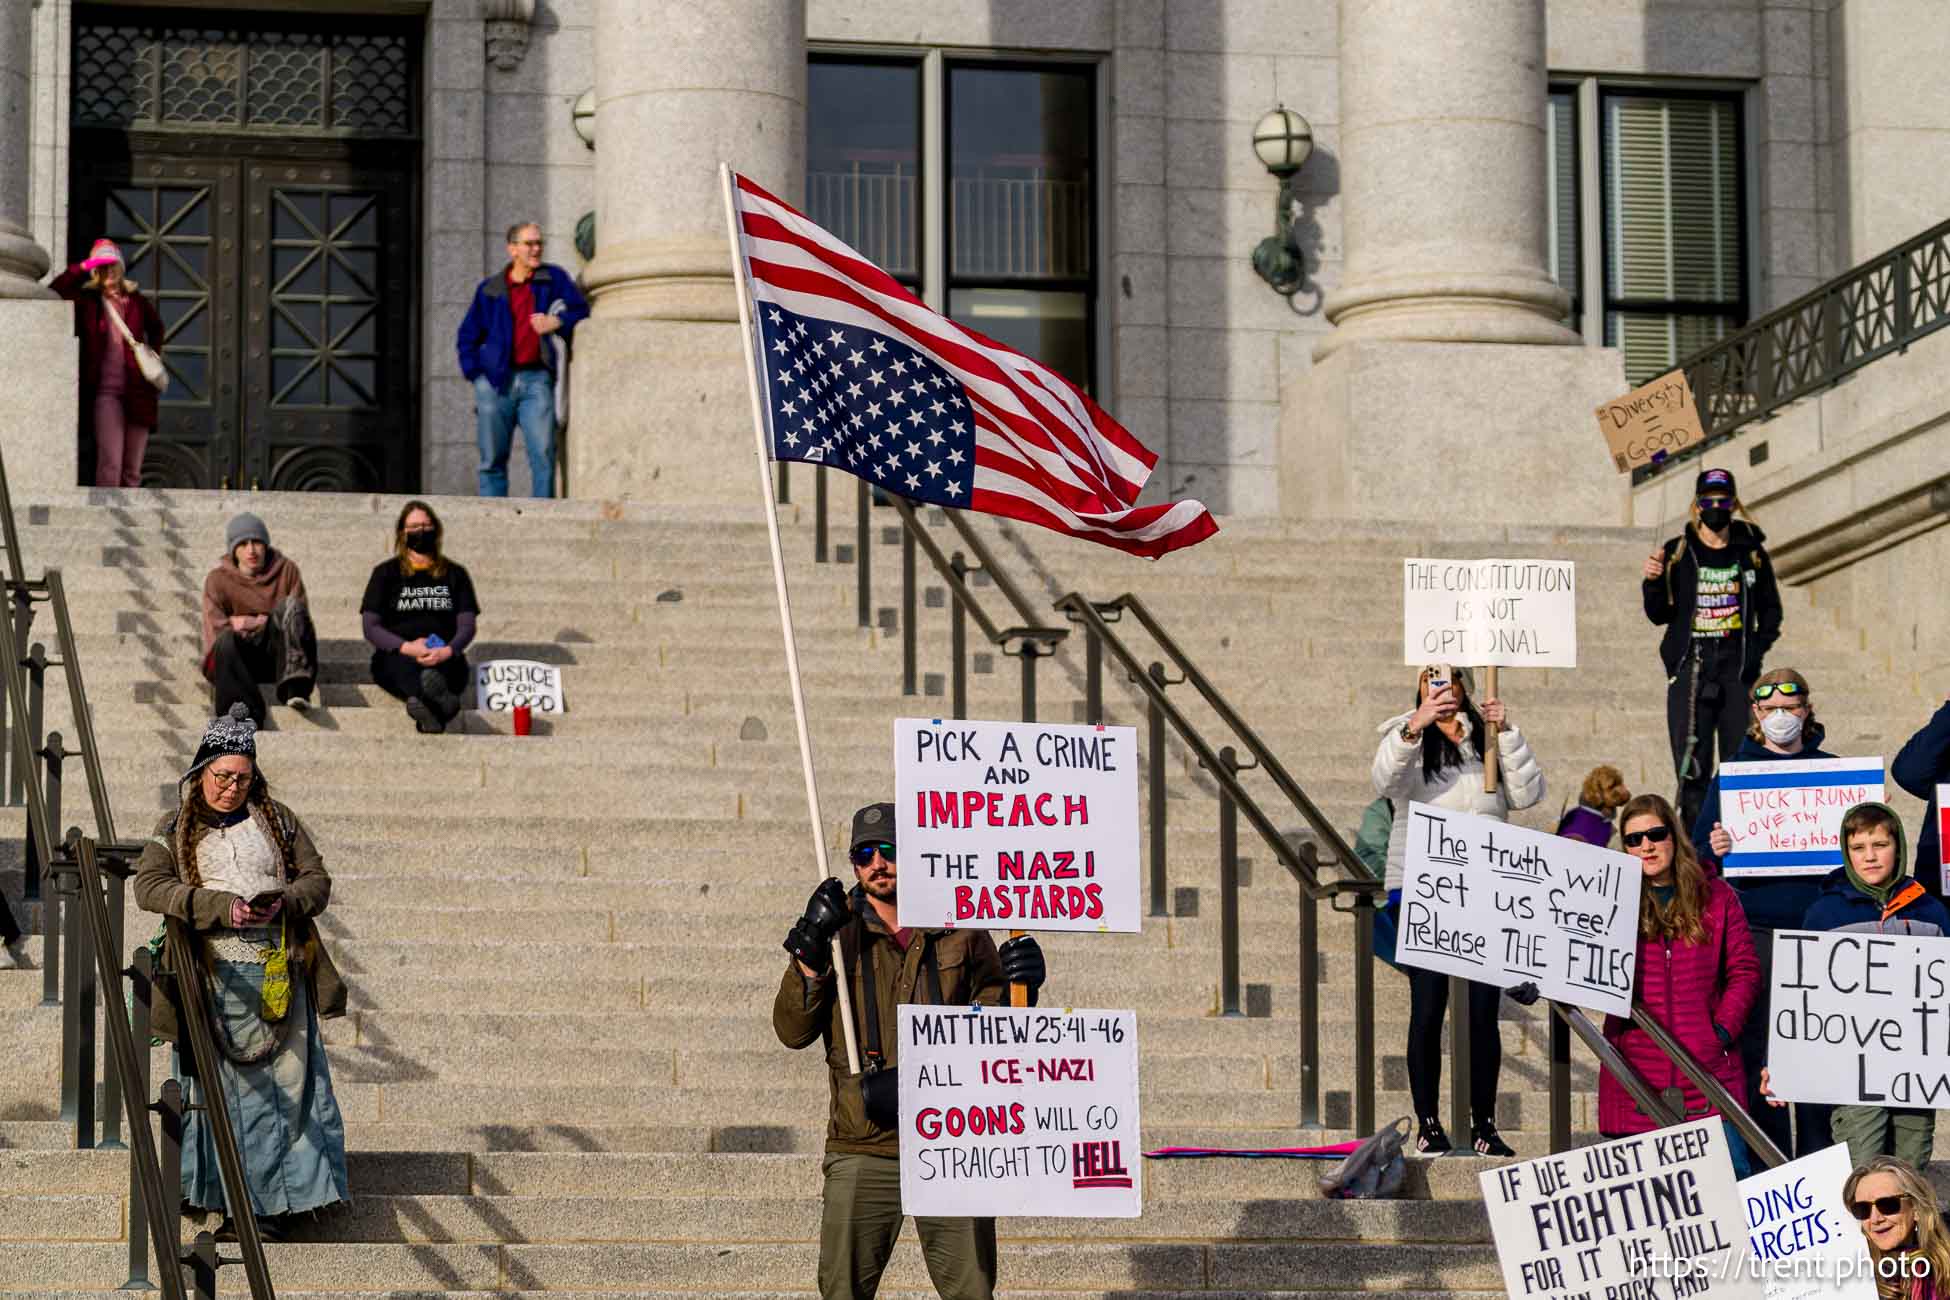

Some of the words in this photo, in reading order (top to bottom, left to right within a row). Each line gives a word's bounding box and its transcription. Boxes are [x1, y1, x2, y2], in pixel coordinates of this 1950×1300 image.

[1609, 383, 1684, 428] Diversity
[1627, 428, 1689, 460] GOOD
[401, 585, 450, 597] JUSTICE
[1407, 563, 1440, 591] THE
[1443, 564, 1572, 592] CONSTITUTION
[397, 597, 453, 611] MATTERS
[1455, 600, 1472, 621] IS
[1486, 598, 1523, 621] NOT
[1423, 629, 1551, 654] OPTONAL
[480, 664, 553, 688] JUSTICE
[506, 682, 536, 694] FOR
[487, 692, 555, 713] GOOD
[917, 730, 981, 762] PICK
[1000, 732, 1022, 762] A
[1036, 732, 1116, 771] CRIME
[984, 766, 1030, 784] AND
[917, 791, 1088, 828] IMPEACH
[1738, 790, 1791, 815] FUCK
[1797, 786, 1868, 807] TRUMP
[1730, 813, 1785, 842] LOVE
[921, 853, 979, 879] THE
[998, 851, 1095, 880] NAZI
[1414, 812, 1468, 859] The
[1481, 832, 1552, 877] truth
[1566, 864, 1621, 902] will
[954, 883, 1104, 920] BASTARDS
[1415, 873, 1469, 907] set
[1495, 891, 1535, 919] us
[1549, 889, 1618, 936] free!
[1406, 901, 1486, 958] Release
[1501, 928, 1548, 968] THE
[1567, 938, 1633, 991] FILES
[1779, 934, 1896, 995] ICE
[1910, 947, 1946, 999] is
[912, 1014, 1029, 1045] MATTHEW
[1035, 1016, 1124, 1044] 25:41-46
[1776, 990, 1903, 1051] above
[918, 1064, 962, 1088] ALL
[981, 1058, 1094, 1085] ICE-NAZI
[1858, 1053, 1950, 1105] Law
[915, 1102, 1025, 1140] GOONS
[1035, 1107, 1078, 1131] WILL
[1087, 1105, 1118, 1130] GO
[918, 1146, 1031, 1181] STRAIGHT
[1036, 1144, 1066, 1175] TO
[1072, 1140, 1128, 1178] HELL
[1498, 1167, 1521, 1203] IF
[1532, 1160, 1570, 1197] WE
[1583, 1140, 1643, 1183] JUST
[1655, 1128, 1710, 1166] KEEP
[1530, 1169, 1704, 1251] FIGHTING
[1747, 1177, 1813, 1230] DING
[1521, 1257, 1566, 1294] FOR
[1577, 1247, 1602, 1282] IT
[1619, 1238, 1652, 1275] WE
[1666, 1220, 1731, 1263] WILL
